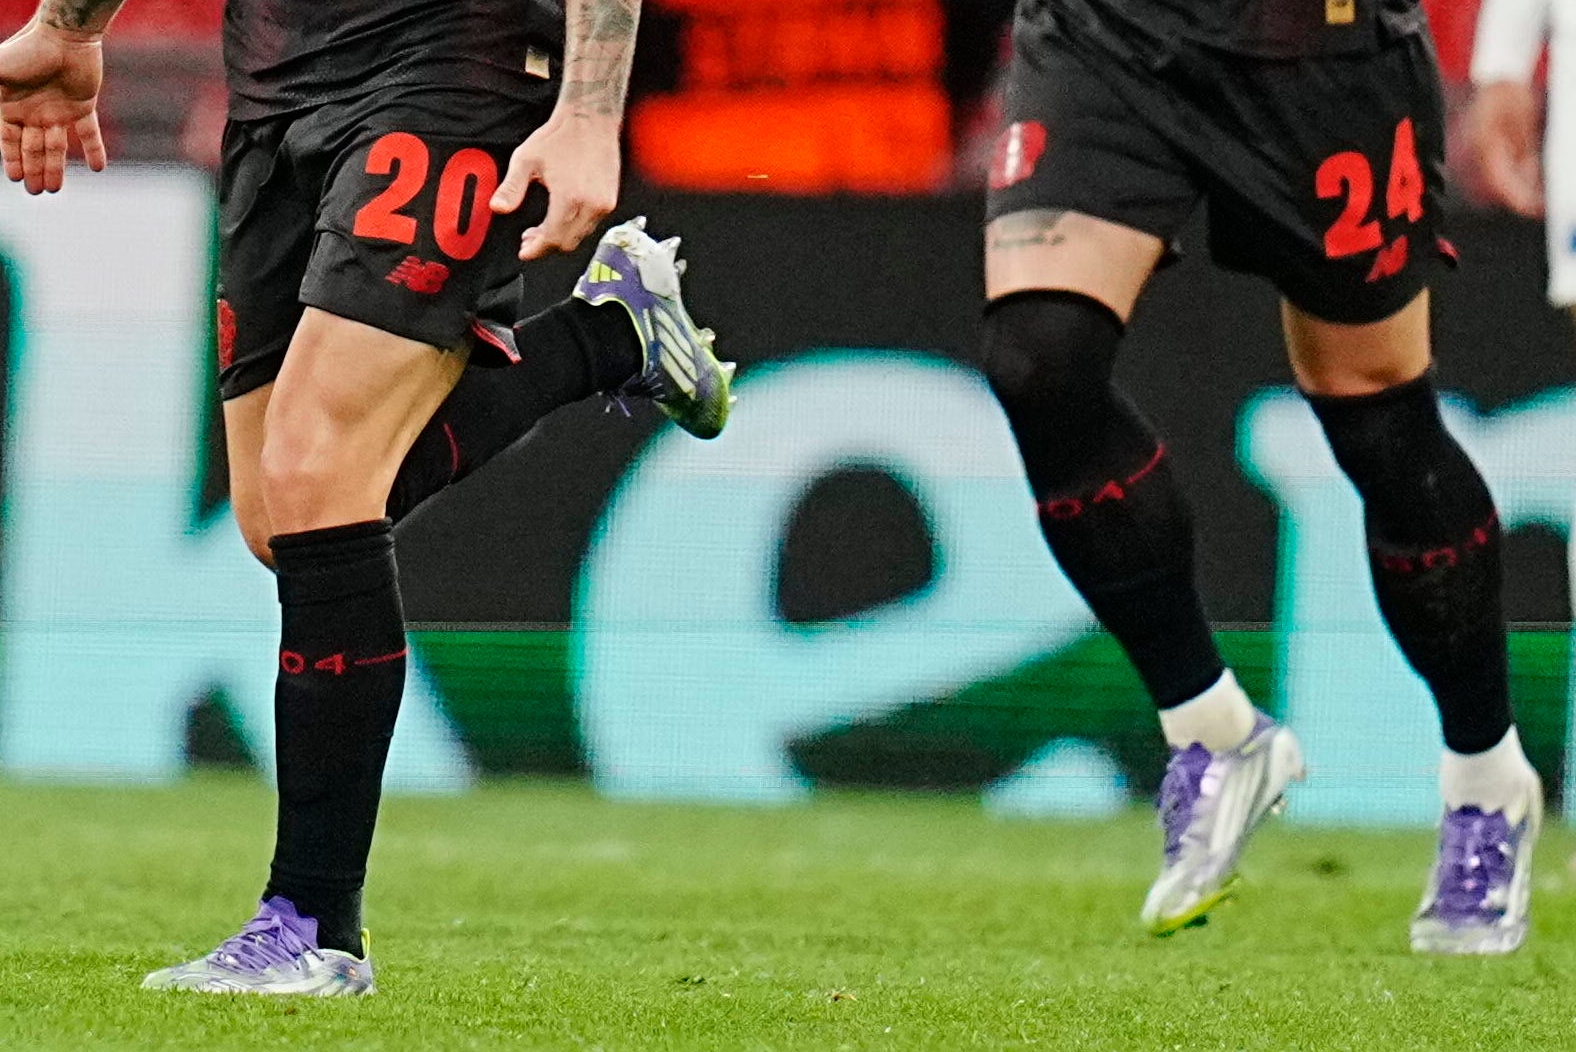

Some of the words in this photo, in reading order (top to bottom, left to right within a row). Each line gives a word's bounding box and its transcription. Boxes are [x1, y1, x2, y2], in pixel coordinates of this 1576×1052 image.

[353, 131, 498, 261] 20
[1315, 116, 1424, 260] 24
[280, 649, 345, 676] 04
